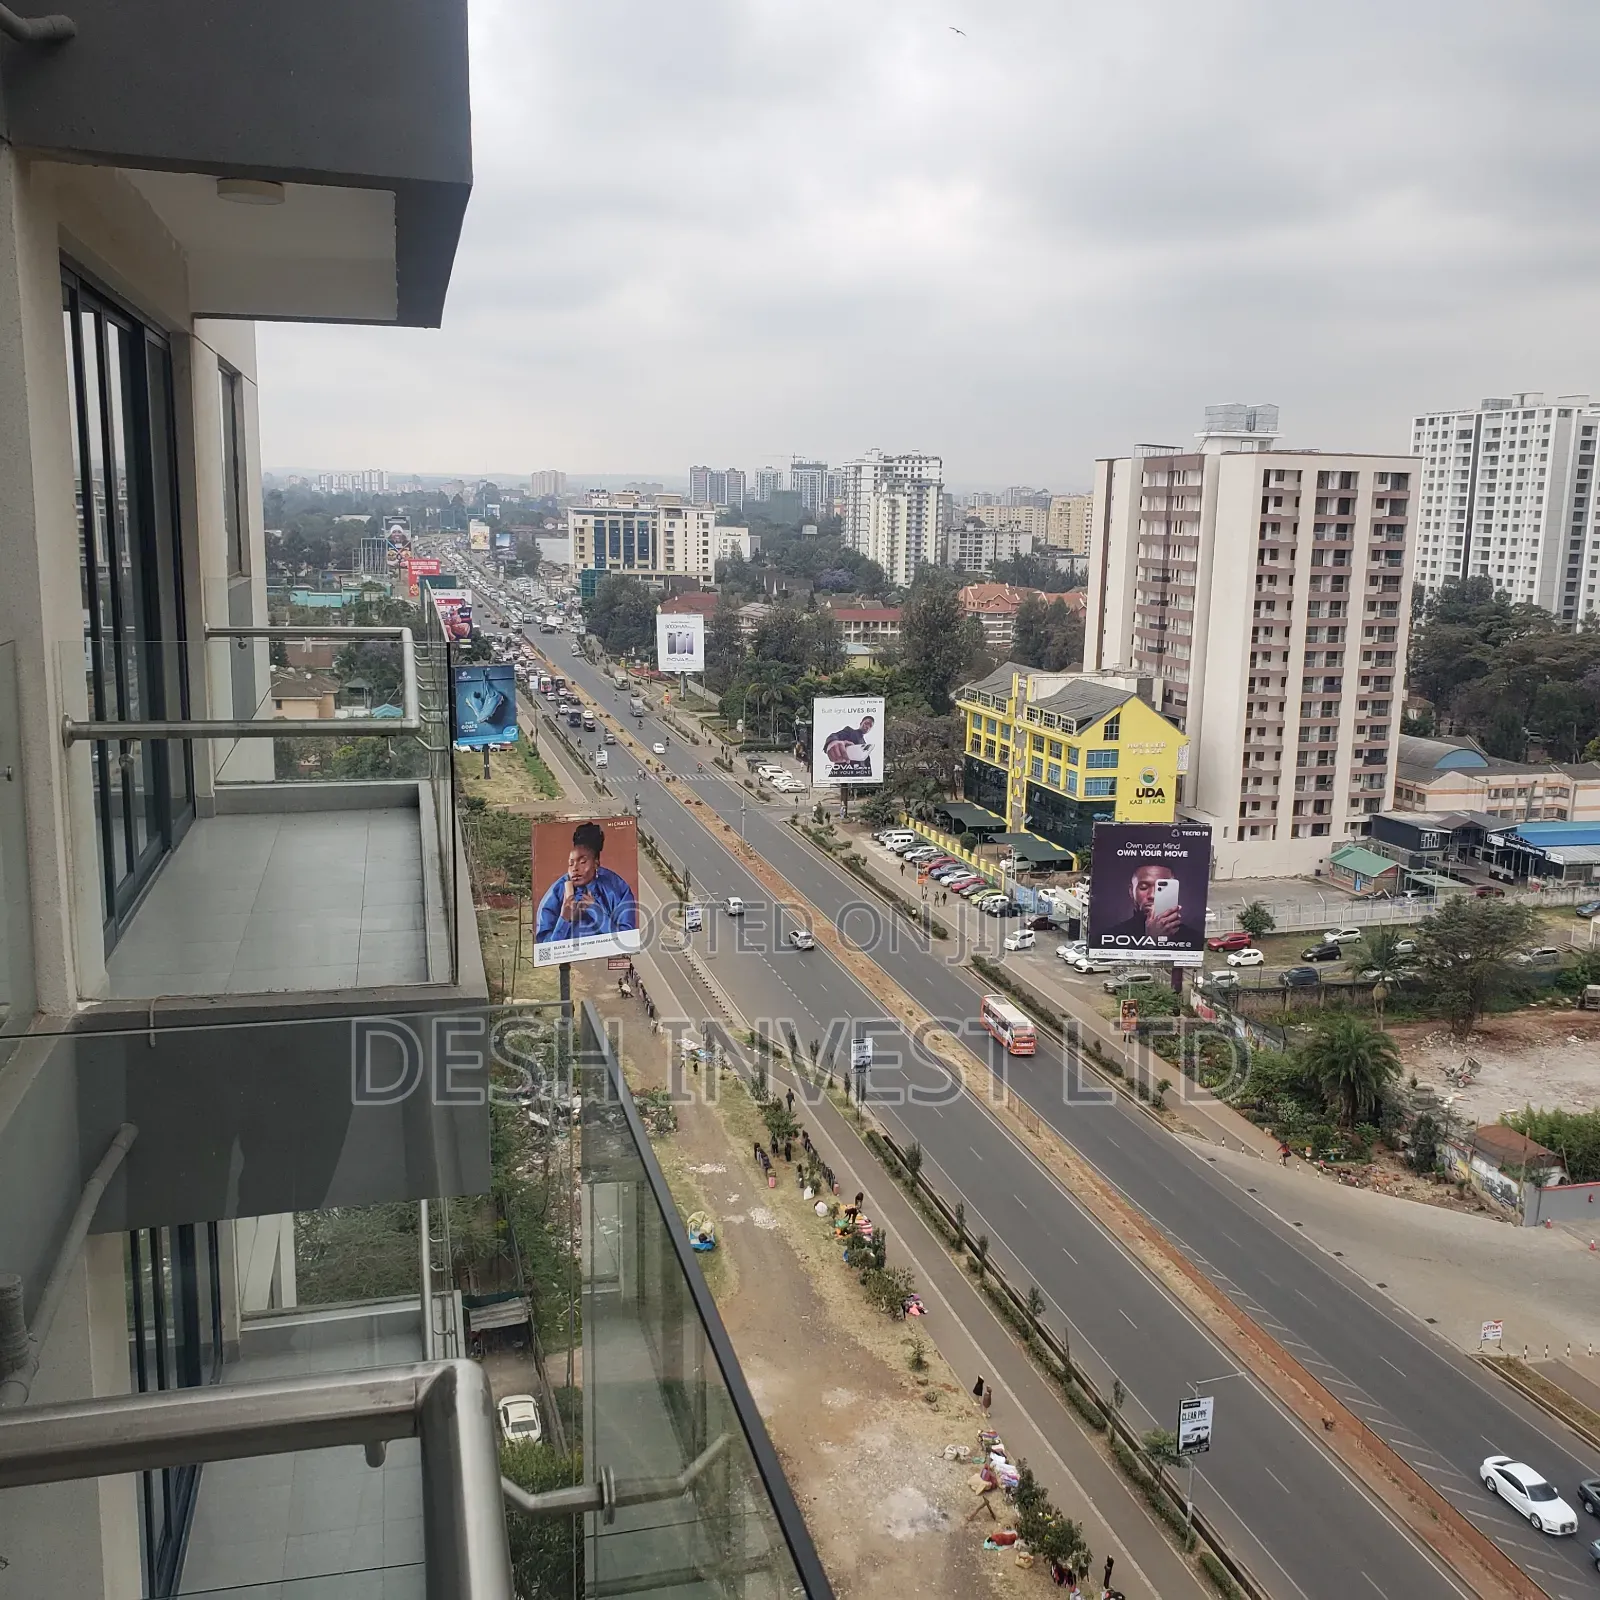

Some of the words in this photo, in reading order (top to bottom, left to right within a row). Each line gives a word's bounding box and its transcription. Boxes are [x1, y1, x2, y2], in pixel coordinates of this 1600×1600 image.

[1136, 788, 1165, 799] UDA
[1144, 843, 1161, 851] your
[1162, 842, 1181, 850] Mind
[1139, 850, 1162, 858] YOUR
[1164, 850, 1189, 858] MOVE
[1101, 934, 1156, 947] POVA
[1182, 1411, 1197, 1421] CLEAR
[1197, 1409, 1208, 1419] PPF
